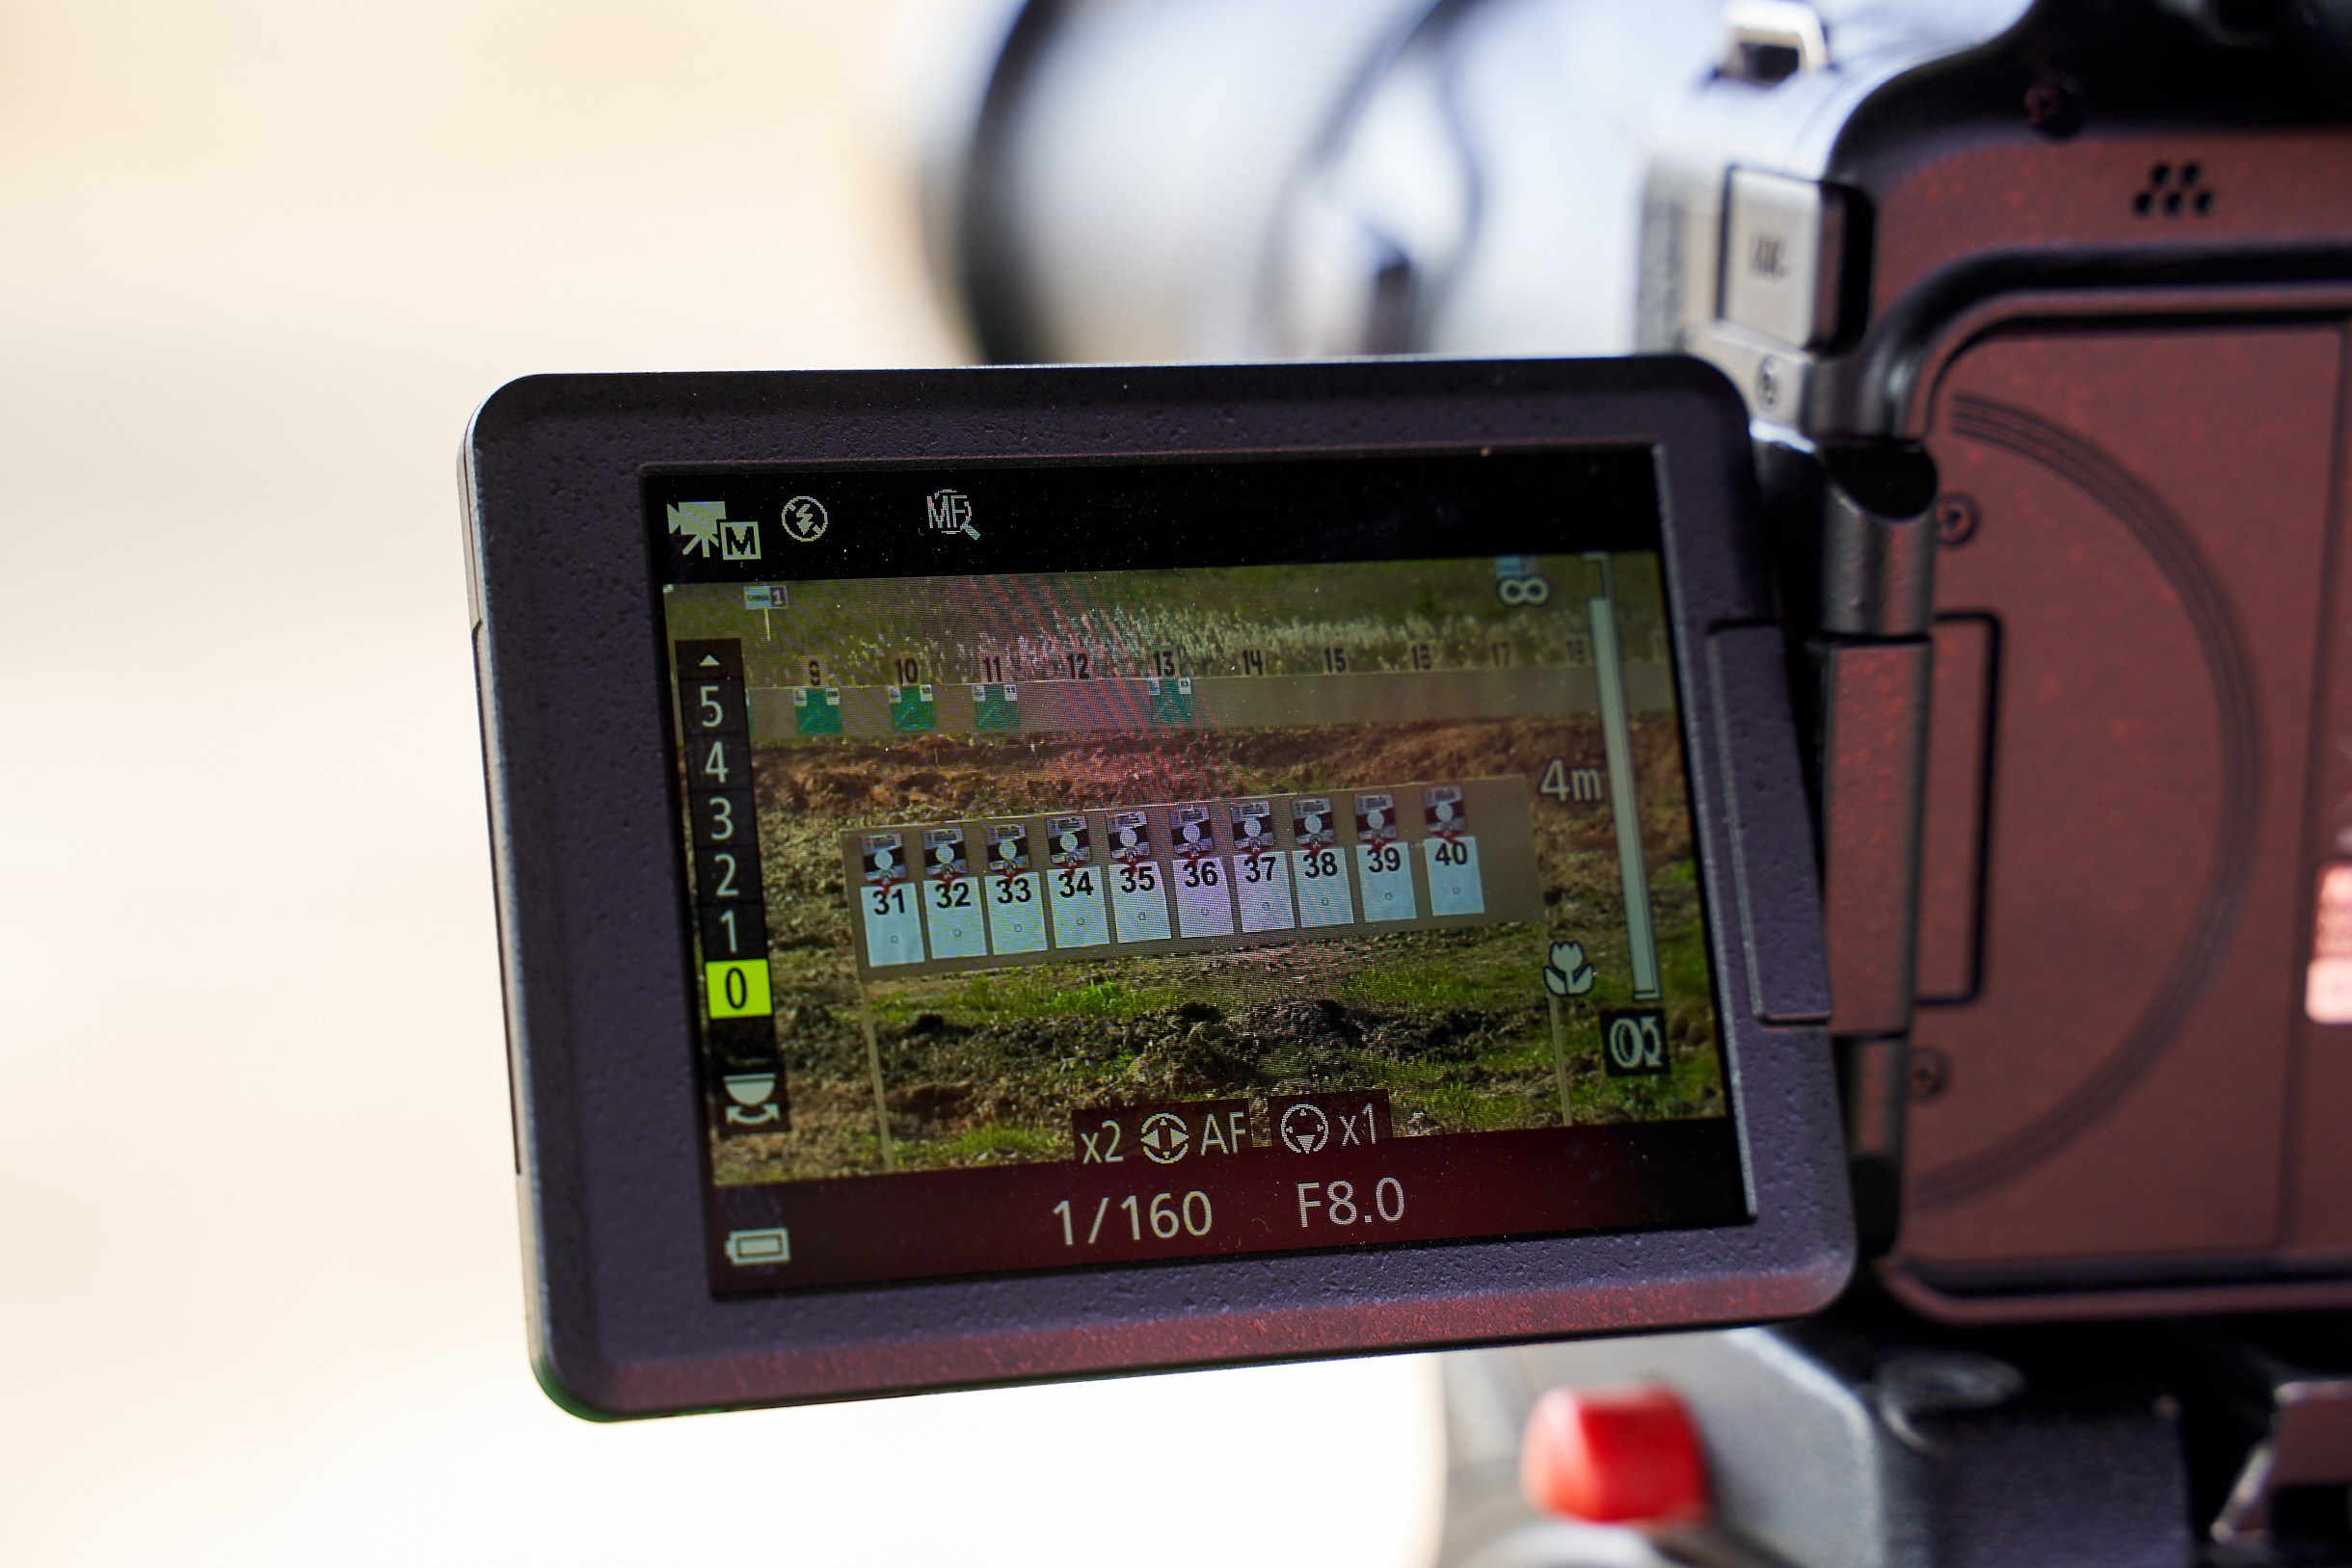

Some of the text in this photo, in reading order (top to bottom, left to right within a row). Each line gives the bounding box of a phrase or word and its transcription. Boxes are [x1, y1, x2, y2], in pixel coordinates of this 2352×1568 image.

[727, 525, 757, 556] M
[808, 659, 820, 686] 9
[895, 657, 920, 684] 10
[983, 655, 1003, 683] 11
[1066, 652, 1090, 679] 12
[1156, 650, 1176, 677] 13
[1242, 649, 1264, 676] 14
[1323, 647, 1347, 673] 15
[1493, 641, 1510, 668] 17
[701, 685, 724, 729] 5
[705, 744, 729, 784] 4
[1539, 758, 1604, 803] 4m
[709, 797, 734, 839] 3
[714, 856, 739, 898] 2
[873, 841, 1469, 916] 31 32 33 34 35 36 37 38 39 40
[719, 910, 740, 953] 1
[725, 967, 748, 1010] 0
[1082, 1103, 1379, 1164] x2 AF x1
[1053, 1177, 1406, 1247] 1/160 F8.0
